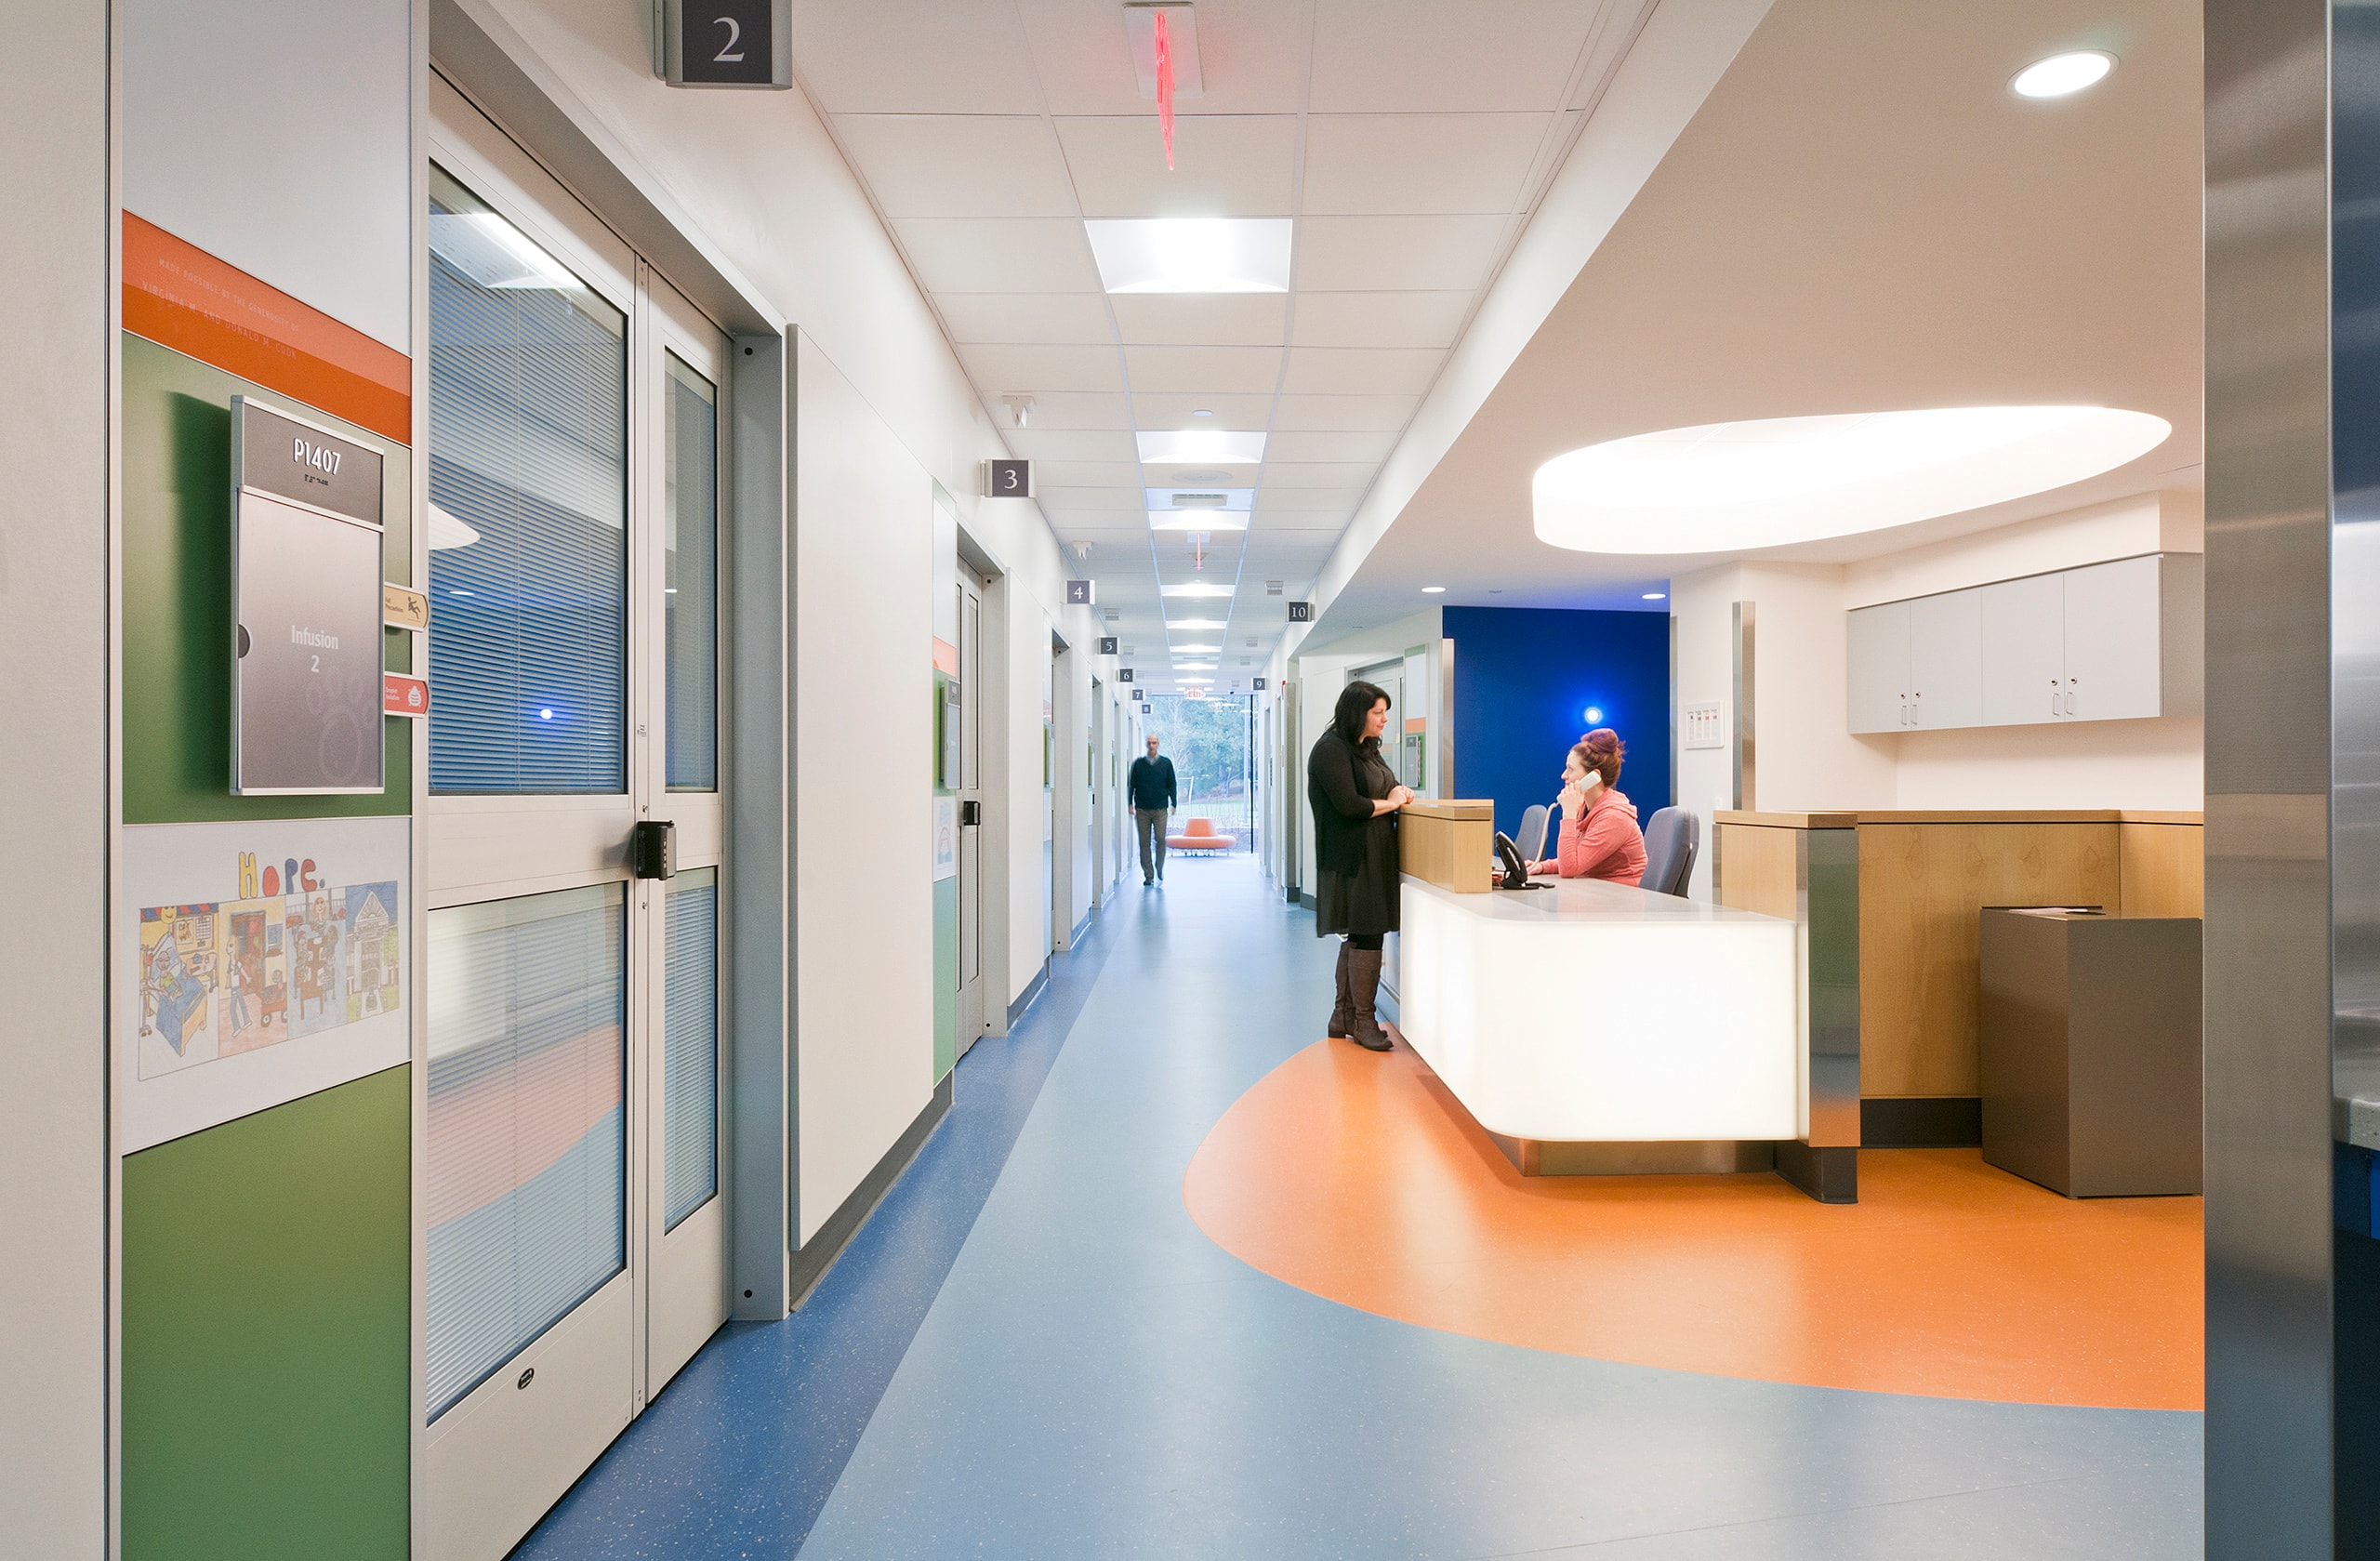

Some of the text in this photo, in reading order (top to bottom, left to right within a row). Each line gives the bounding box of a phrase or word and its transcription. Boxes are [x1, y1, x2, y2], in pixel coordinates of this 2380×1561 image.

[713, 17, 745, 62] 2
[158, 258, 179, 274] MADE
[183, 269, 218, 294] POSSIBLE
[221, 288, 231, 299] BY
[233, 294, 245, 307] THE
[248, 301, 289, 327] GENEROSITY
[141, 280, 184, 308] VIRGINIA
[203, 309, 220, 325] AND
[224, 319, 258, 342] DONALD
[275, 342, 297, 360] COOK
[294, 438, 341, 475] P1407
[1004, 470, 1018, 489] 3
[1074, 587, 1083, 600] 4
[1291, 607, 1306, 618] 10
[291, 625, 339, 650] Infusion
[1106, 642, 1113, 652] 5
[311, 655, 320, 673] 2
